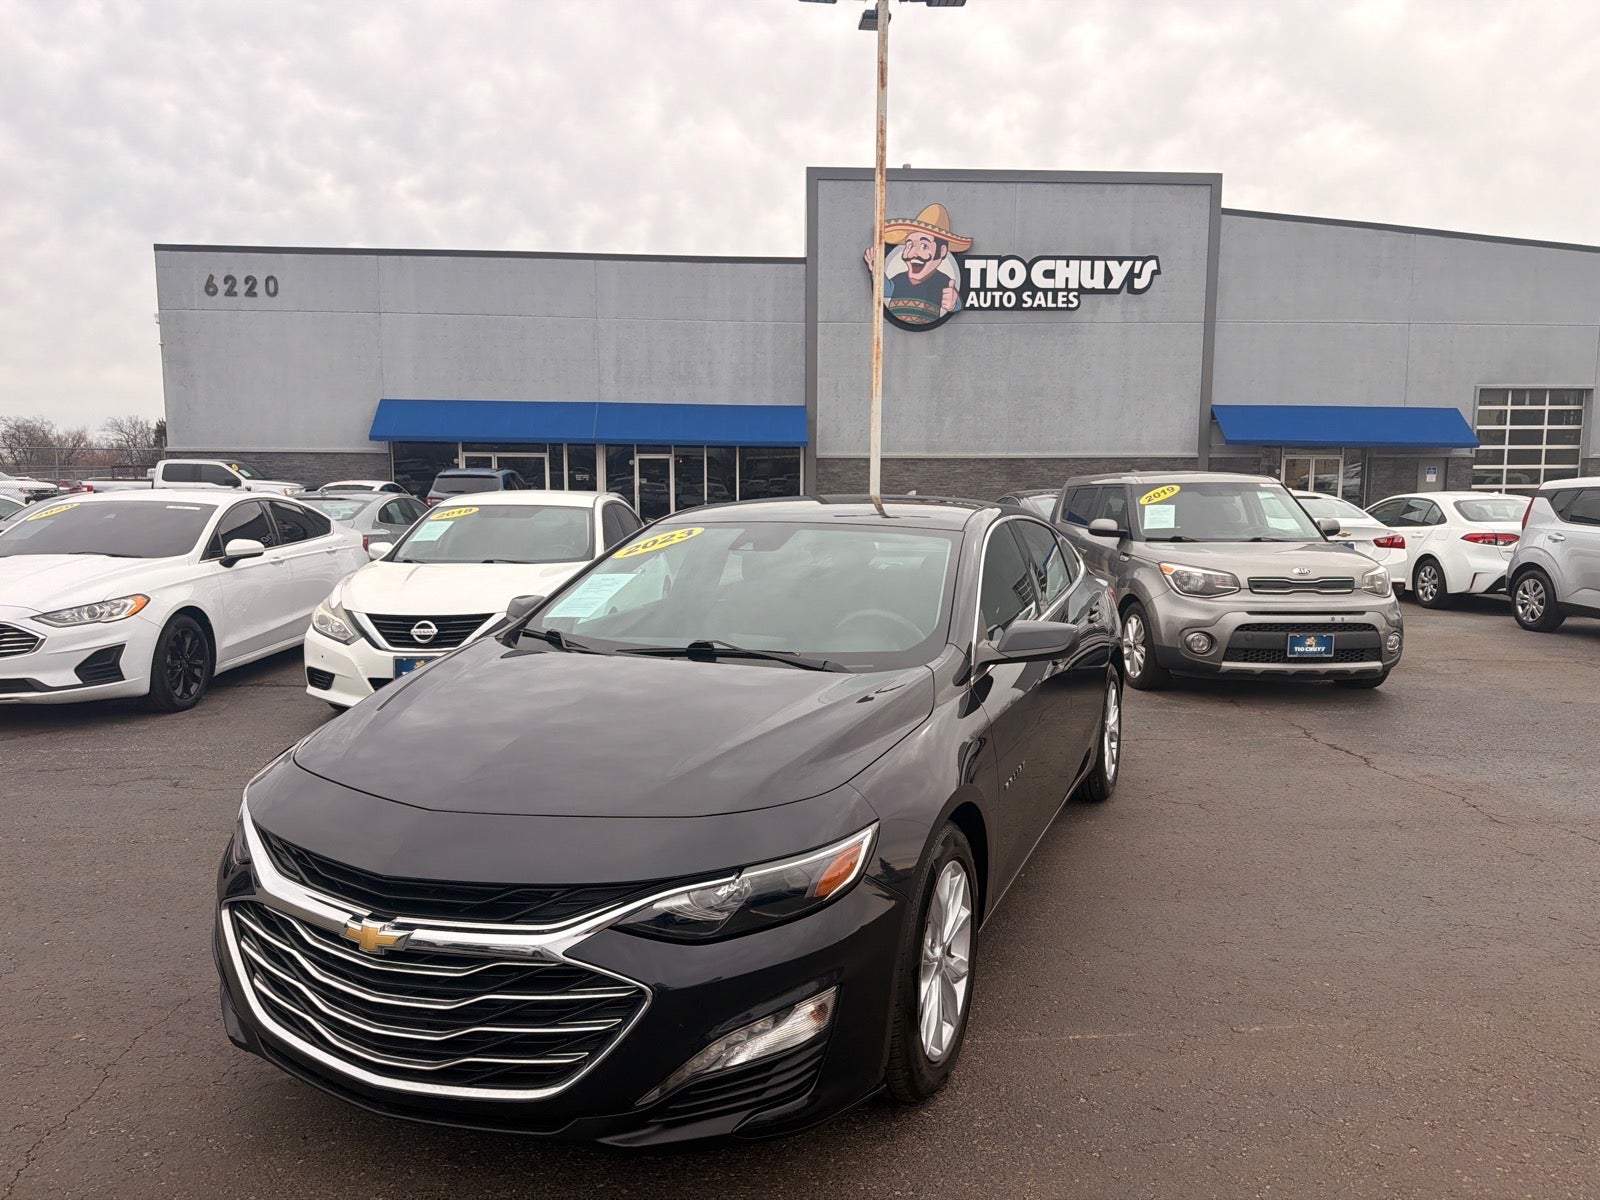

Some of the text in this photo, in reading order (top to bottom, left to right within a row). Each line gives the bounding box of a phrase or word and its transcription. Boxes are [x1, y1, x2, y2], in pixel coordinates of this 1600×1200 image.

[204, 273, 279, 298] 6220
[964, 259, 1158, 290] TIO CHUY'S
[965, 291, 1079, 308] AUTO SALES
[1145, 486, 1175, 503] 2019
[623, 528, 695, 556] 2023
